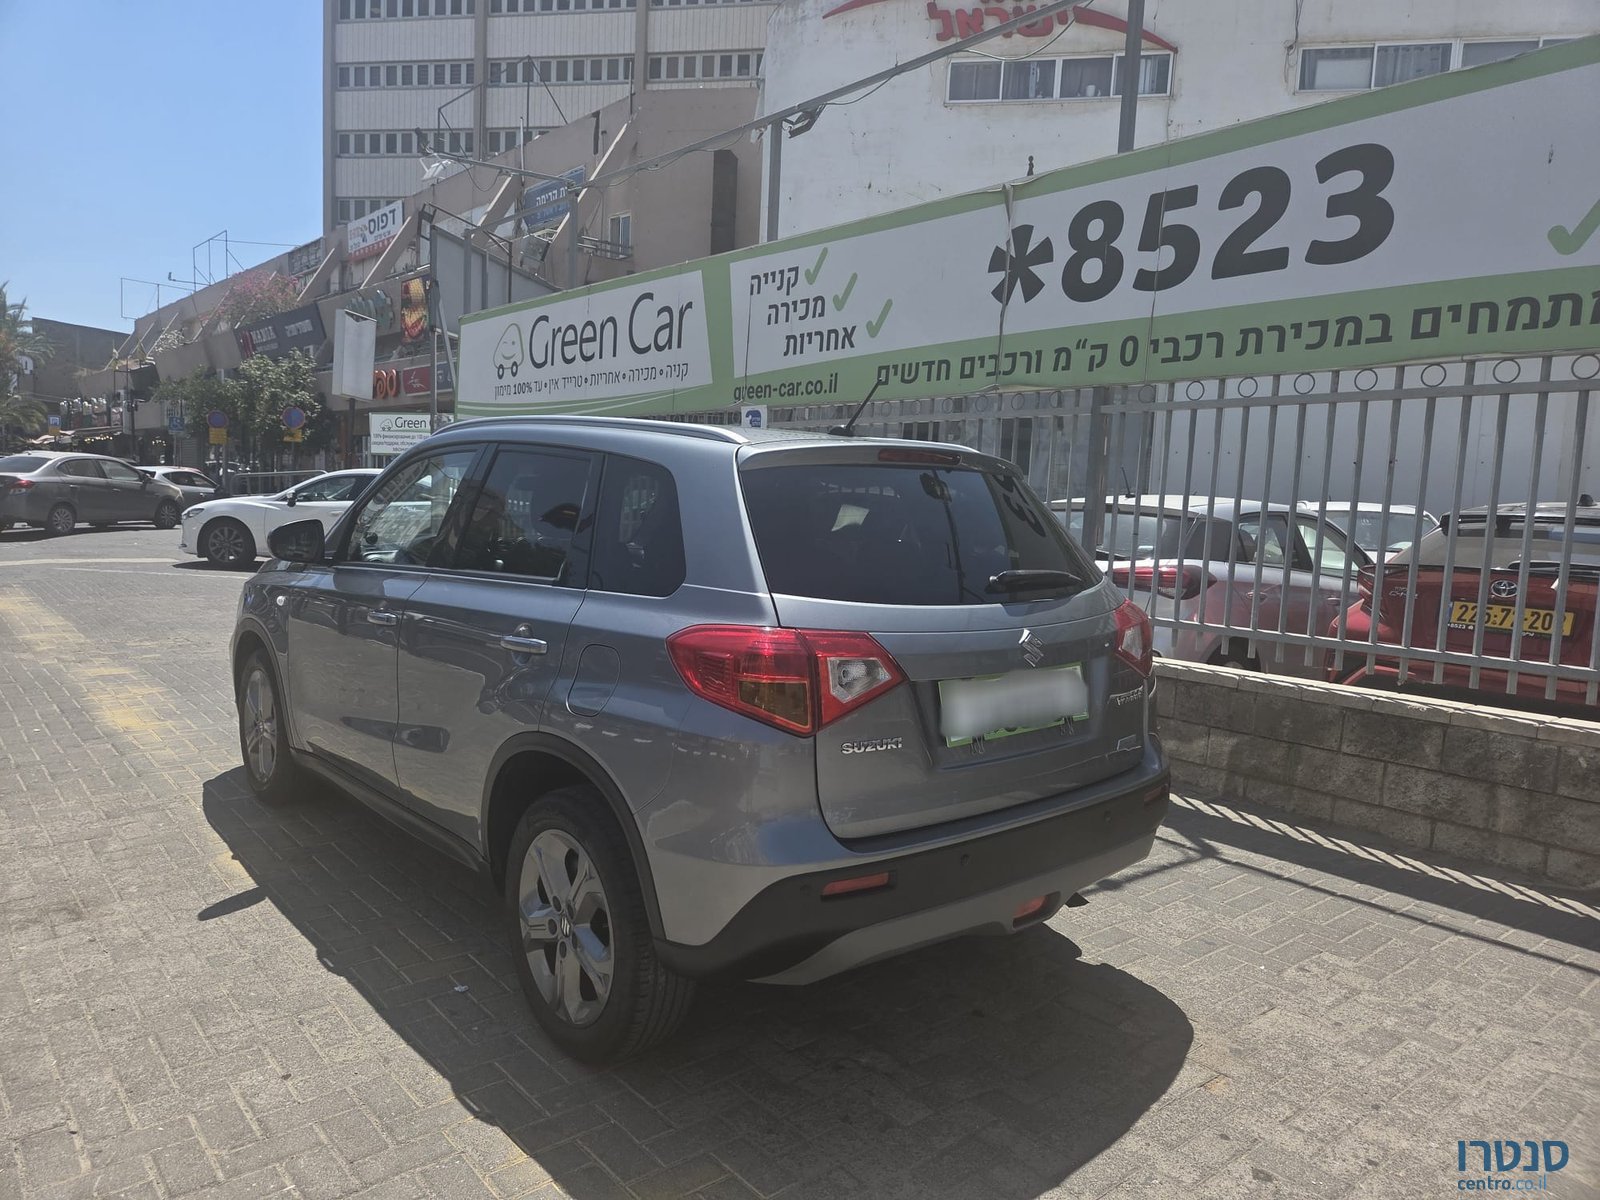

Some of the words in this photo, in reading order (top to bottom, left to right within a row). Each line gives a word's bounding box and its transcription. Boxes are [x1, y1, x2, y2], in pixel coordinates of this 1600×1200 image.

[368, 208, 396, 235] דפוס
[750, 266, 799, 296] קנייה
[767, 295, 826, 325] מכירה
[529, 315, 618, 369] Green
[628, 292, 693, 355] Car
[783, 325, 857, 357] אחריות
[1235, 313, 1393, 357] במכירת
[1149, 331, 1224, 364] רכבי
[628, 366, 657, 382] מכירה
[665, 363, 689, 382] קניה
[877, 359, 951, 386] חדשים
[960, 349, 1043, 380] ורכבים
[513, 381, 533, 396] 100%
[534, 380, 543, 393] עד
[548, 378, 560, 395] אין
[562, 375, 583, 390] טרייד
[589, 370, 621, 387] אחריות
[733, 373, 838, 401] green-car.co.il
[494, 383, 511, 401] מימון
[394, 416, 427, 429] Green
[841, 737, 903, 755] SUZUKI
